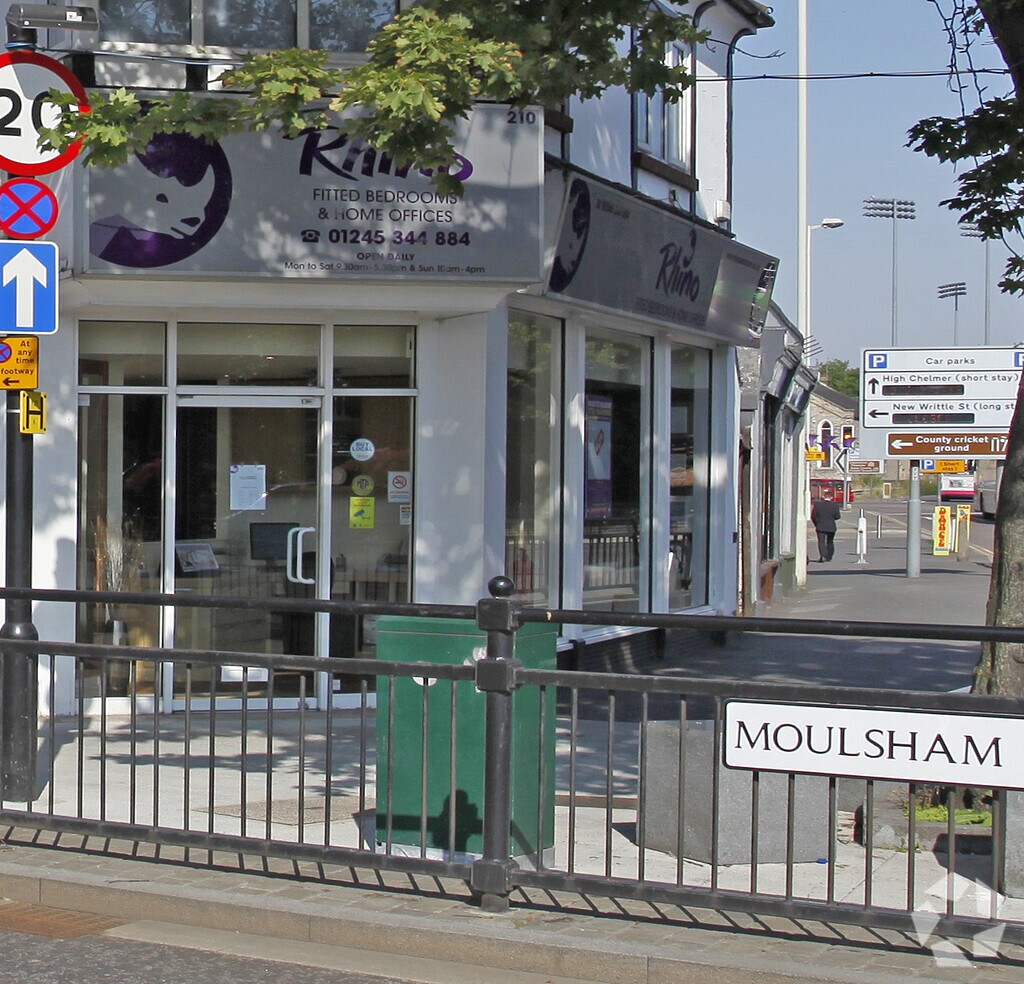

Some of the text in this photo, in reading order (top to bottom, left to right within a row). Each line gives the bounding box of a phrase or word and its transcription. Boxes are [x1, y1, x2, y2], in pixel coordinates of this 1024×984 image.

[507, 111, 536, 124] 210
[313, 188, 458, 205] FITTED BEDROOMS
[318, 208, 453, 223] & HOME OFFICES
[328, 229, 471, 246] 01245 344 884
[356, 252, 415, 262] OPEN DAILY
[284, 262, 305, 270] Mon
[308, 262, 317, 270] to
[319, 262, 334, 271] Sat
[418, 264, 435, 273] Sun
[656, 242, 700, 302] Rhino
[925, 357, 975, 367] Car parks
[882, 374, 1019, 383] High Chelmer (short stay)
[26, 396, 43, 429] H
[919, 403, 954, 411] Writtle
[958, 403, 971, 411] St
[973, 403, 1001, 412] (long
[915, 435, 989, 445] County cricket
[934, 444, 970, 453] ground
[734, 720, 1003, 768] MOULSHAM
